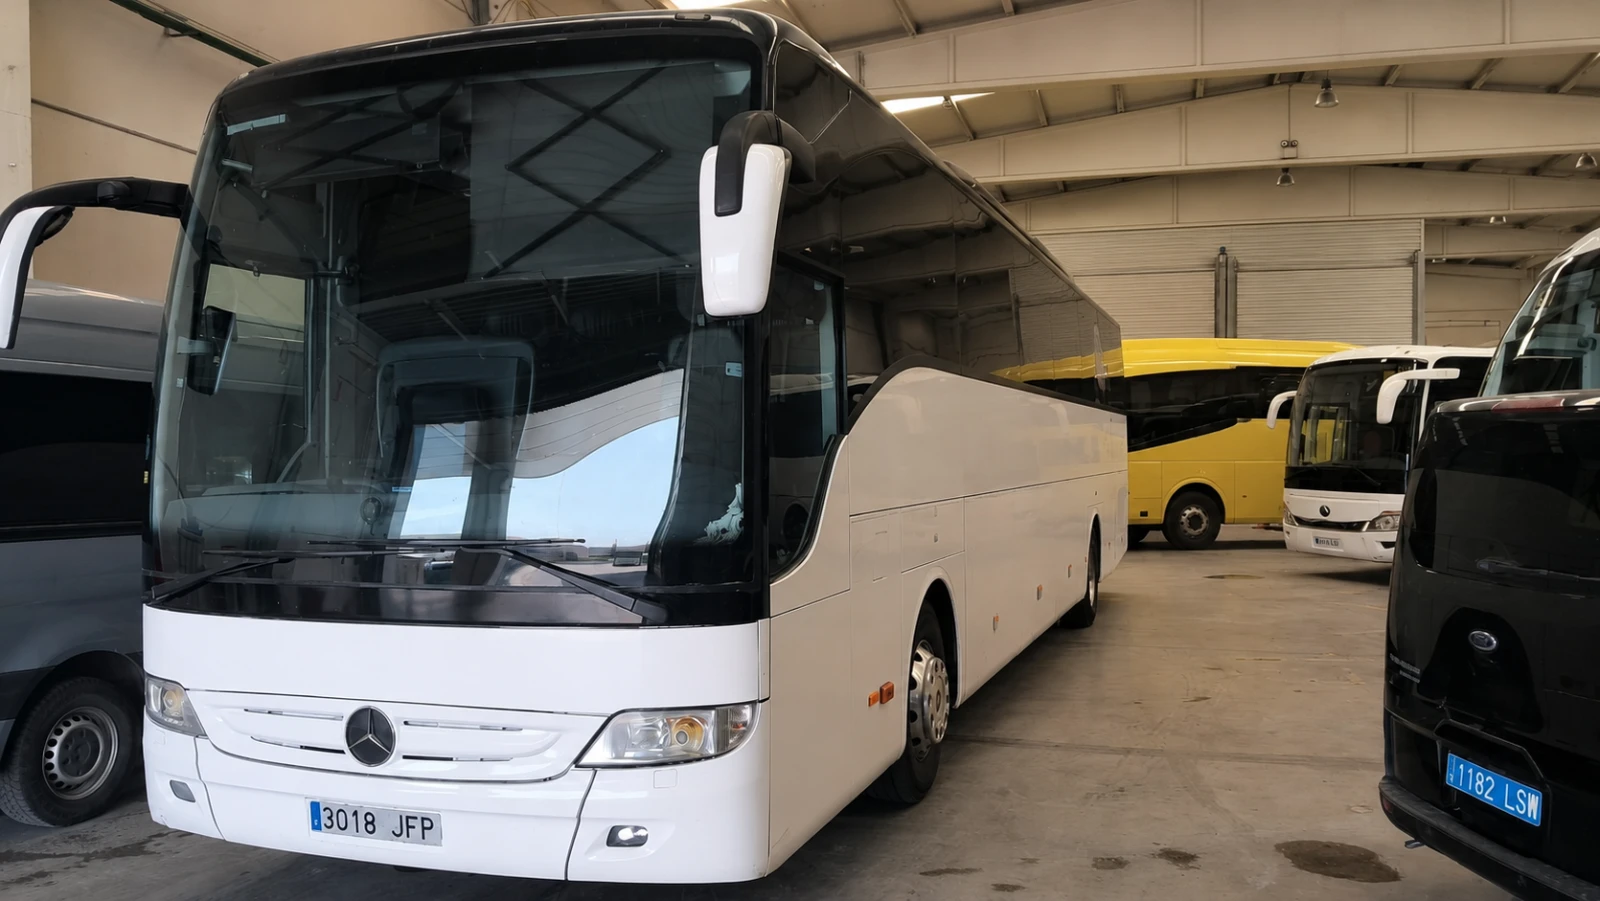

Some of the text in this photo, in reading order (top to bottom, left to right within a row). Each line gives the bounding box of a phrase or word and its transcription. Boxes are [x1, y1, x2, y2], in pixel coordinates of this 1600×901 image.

[1459, 763, 1539, 820] 1182 LSW
[322, 806, 434, 840] 3018 JFP
